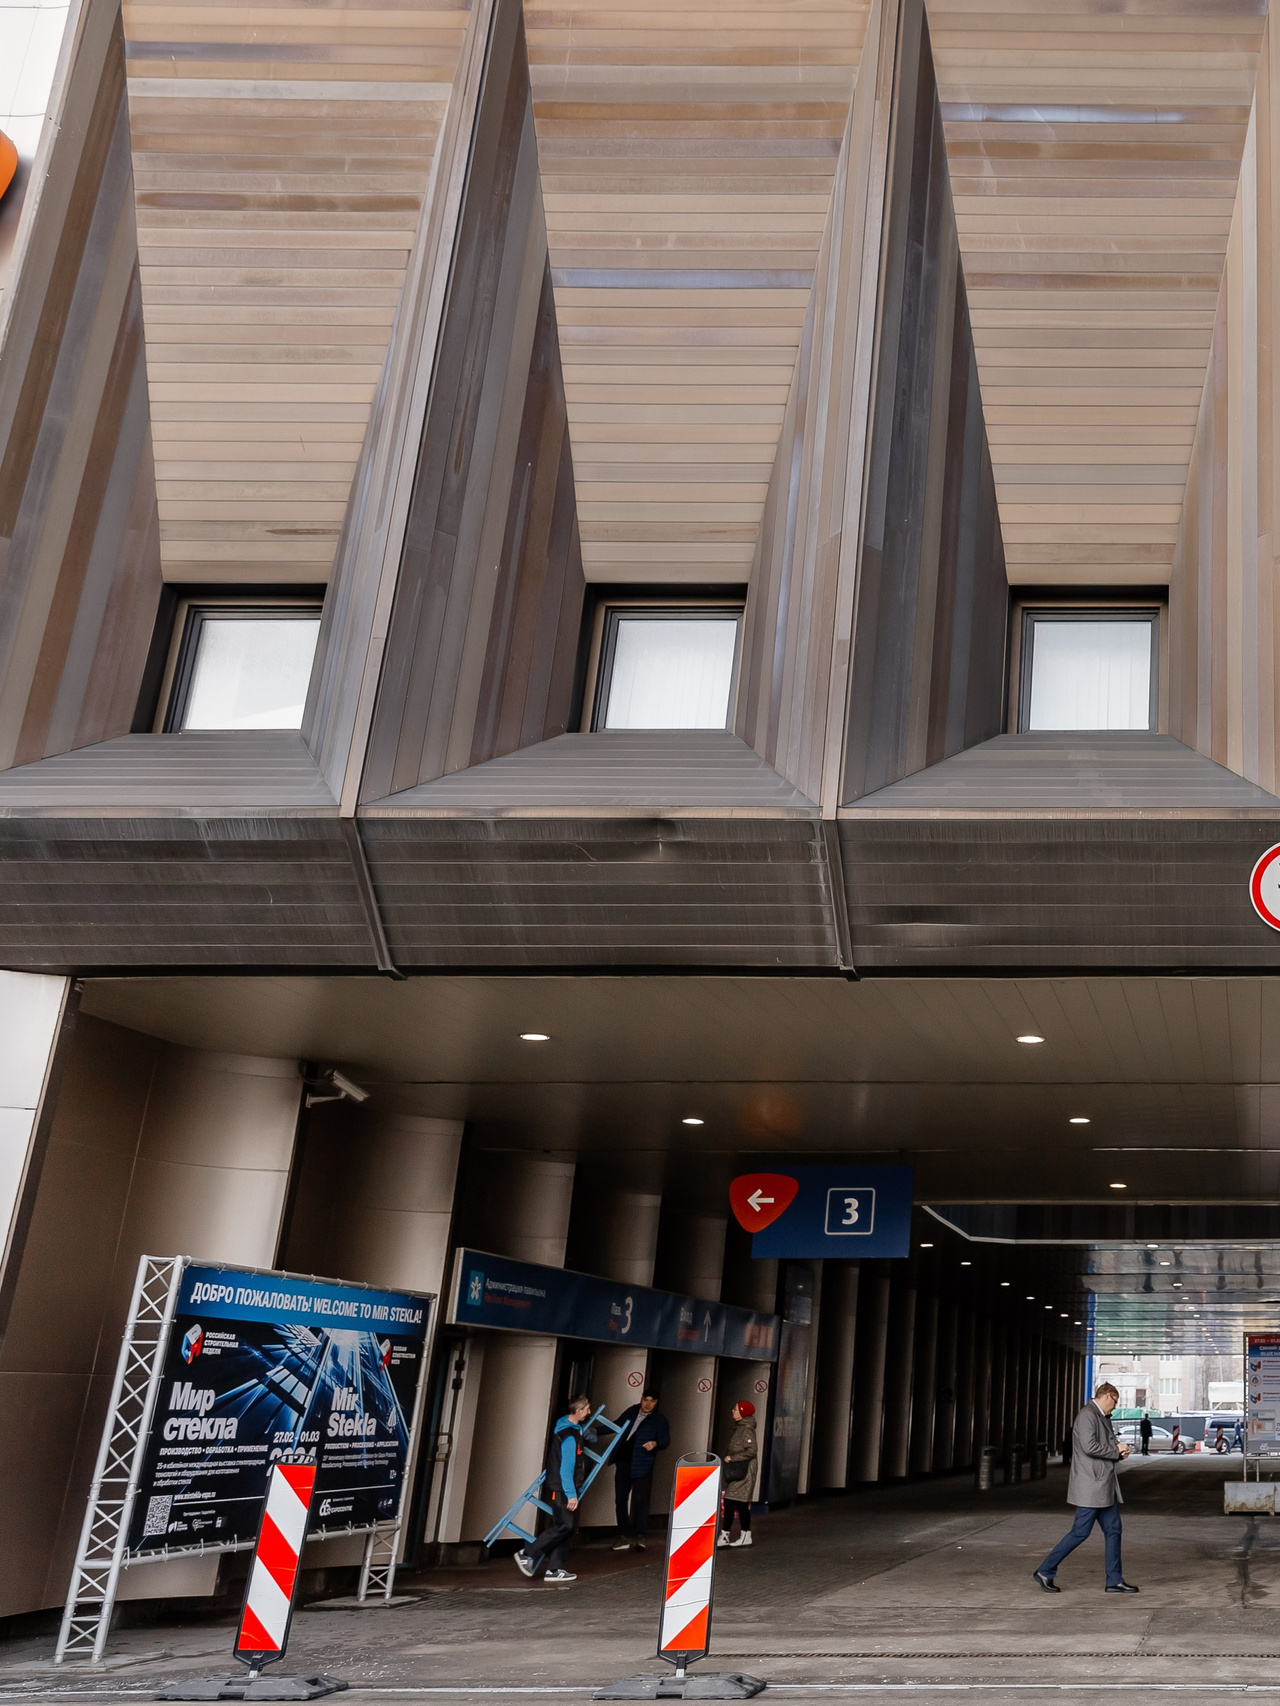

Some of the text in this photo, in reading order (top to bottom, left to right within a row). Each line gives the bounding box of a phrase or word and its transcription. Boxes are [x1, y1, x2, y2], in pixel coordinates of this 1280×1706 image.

[841, 1197, 859, 1225] 3
[190, 1282, 313, 1312] ДОБРО ПОЖАЛОВАТЬ!
[313, 1297, 423, 1323] WELCOME TO MIR STEKLA!
[621, 1296, 633, 1334] 3
[168, 1381, 215, 1417] Мир
[331, 1387, 359, 1411] Mir
[163, 1417, 238, 1441] стекла
[273, 1431, 320, 1443] 27.02 01.03
[327, 1412, 377, 1437] Stekla
[159, 1446, 202, 1456] ПРОИЗВОДСТВО
[205, 1446, 234, 1454] ОБРАБОТКА
